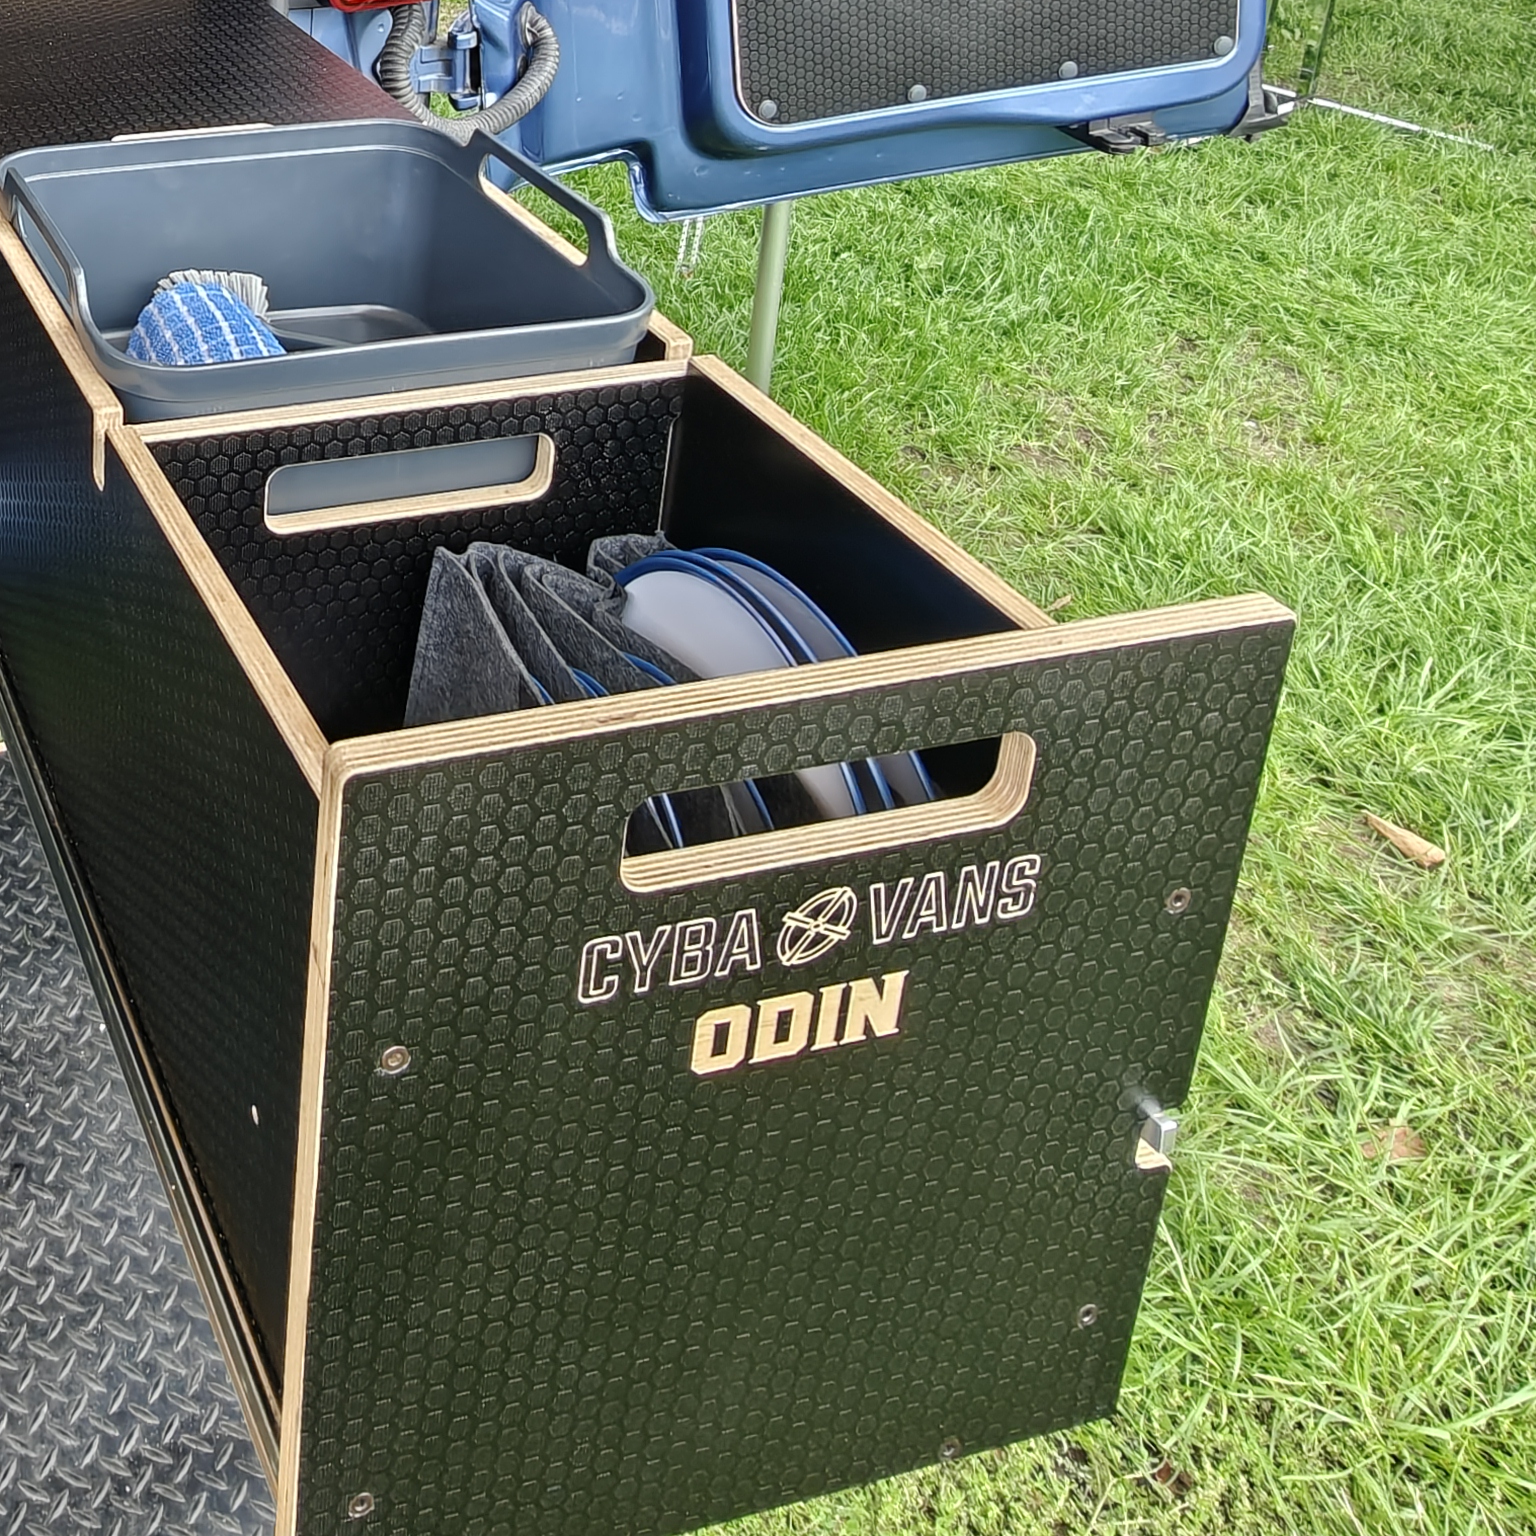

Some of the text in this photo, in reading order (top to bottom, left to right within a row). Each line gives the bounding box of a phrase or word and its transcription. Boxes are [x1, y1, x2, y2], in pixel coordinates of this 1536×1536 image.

[577, 854, 1041, 1004] CYBA VANS
[690, 969, 910, 1076] ODIN
